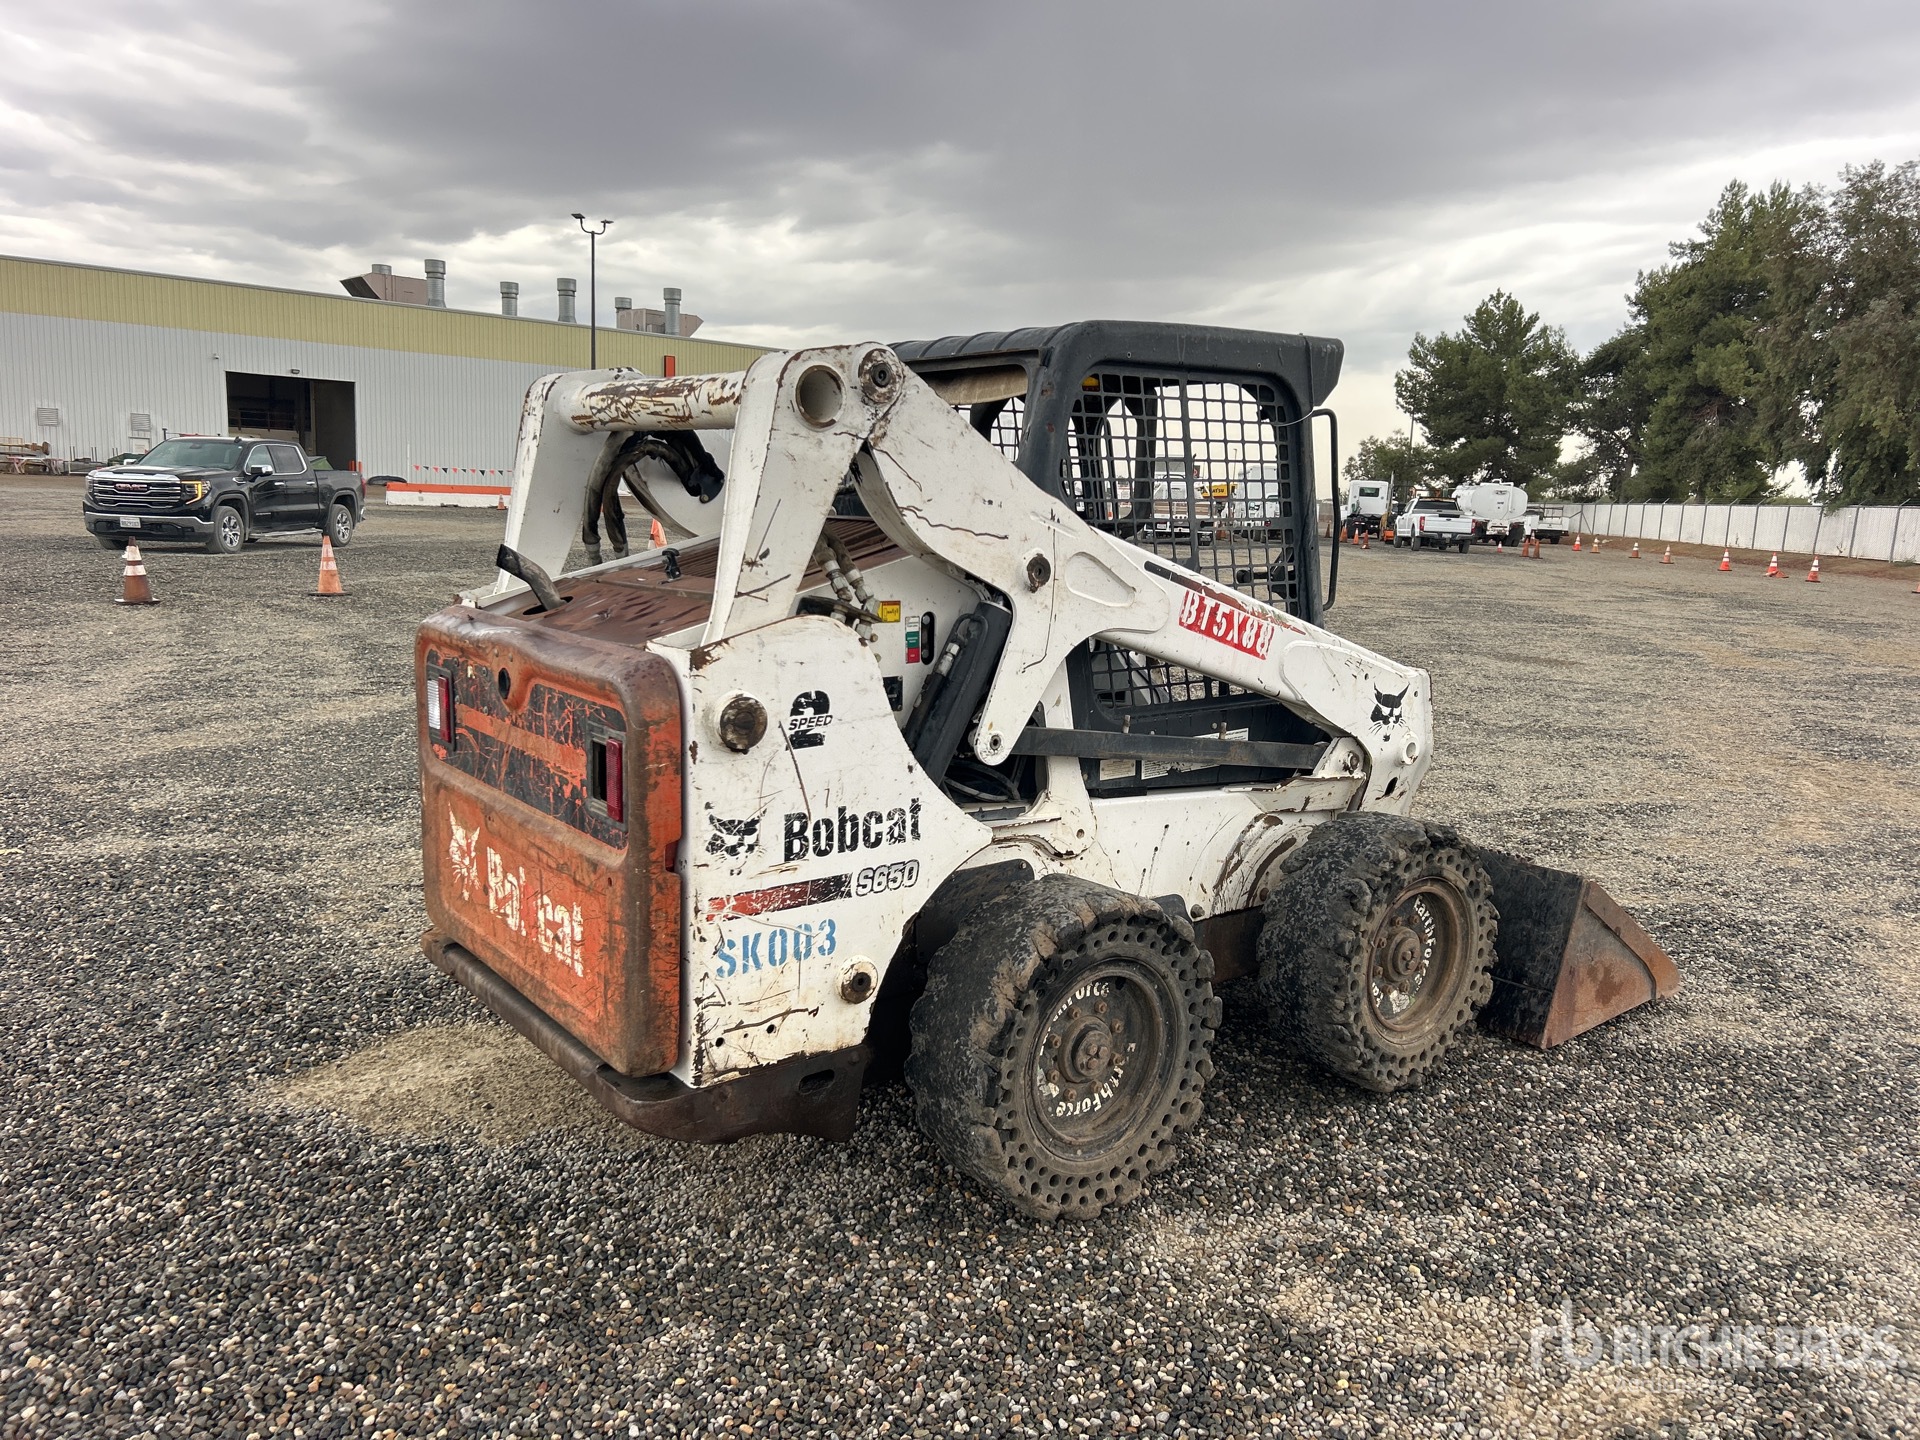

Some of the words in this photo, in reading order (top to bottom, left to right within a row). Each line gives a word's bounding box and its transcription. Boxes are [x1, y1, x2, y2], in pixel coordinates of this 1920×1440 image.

[115, 483, 148, 491] GMC
[1180, 589, 1274, 657] BT5X88
[788, 715, 833, 731] SPEED
[789, 690, 830, 749] 2
[783, 797, 922, 863] Bobcat
[855, 859, 920, 897] S650
[715, 918, 837, 978] SK003
